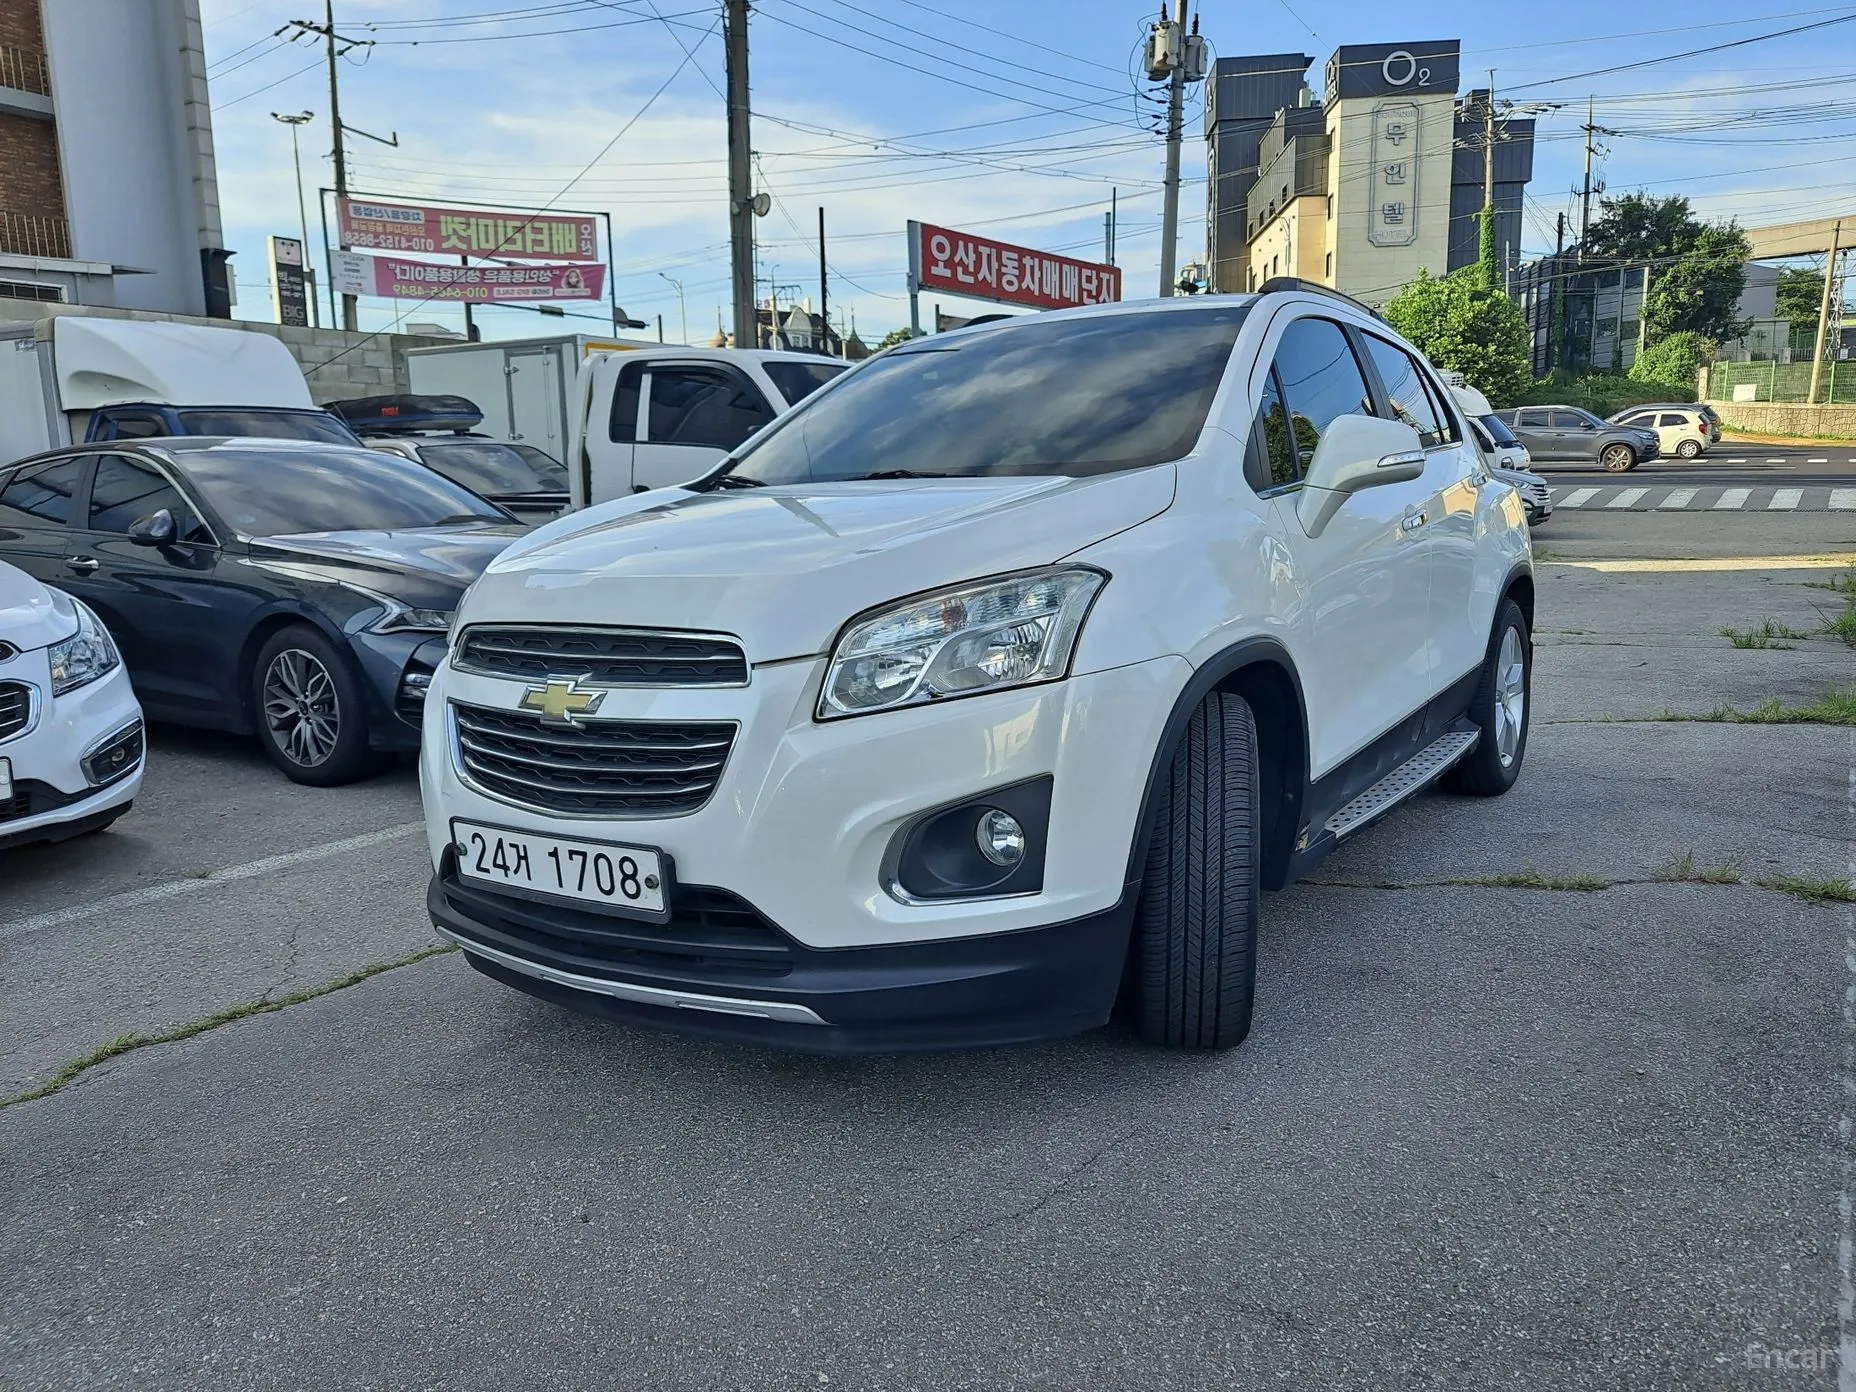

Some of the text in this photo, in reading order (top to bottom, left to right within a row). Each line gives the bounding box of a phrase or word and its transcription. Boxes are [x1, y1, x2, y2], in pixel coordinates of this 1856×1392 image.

[1382, 121, 1407, 225] 무인텔
[930, 234, 1115, 304] 오산자동차매매단지
[471, 832, 642, 900] 24거 1708
